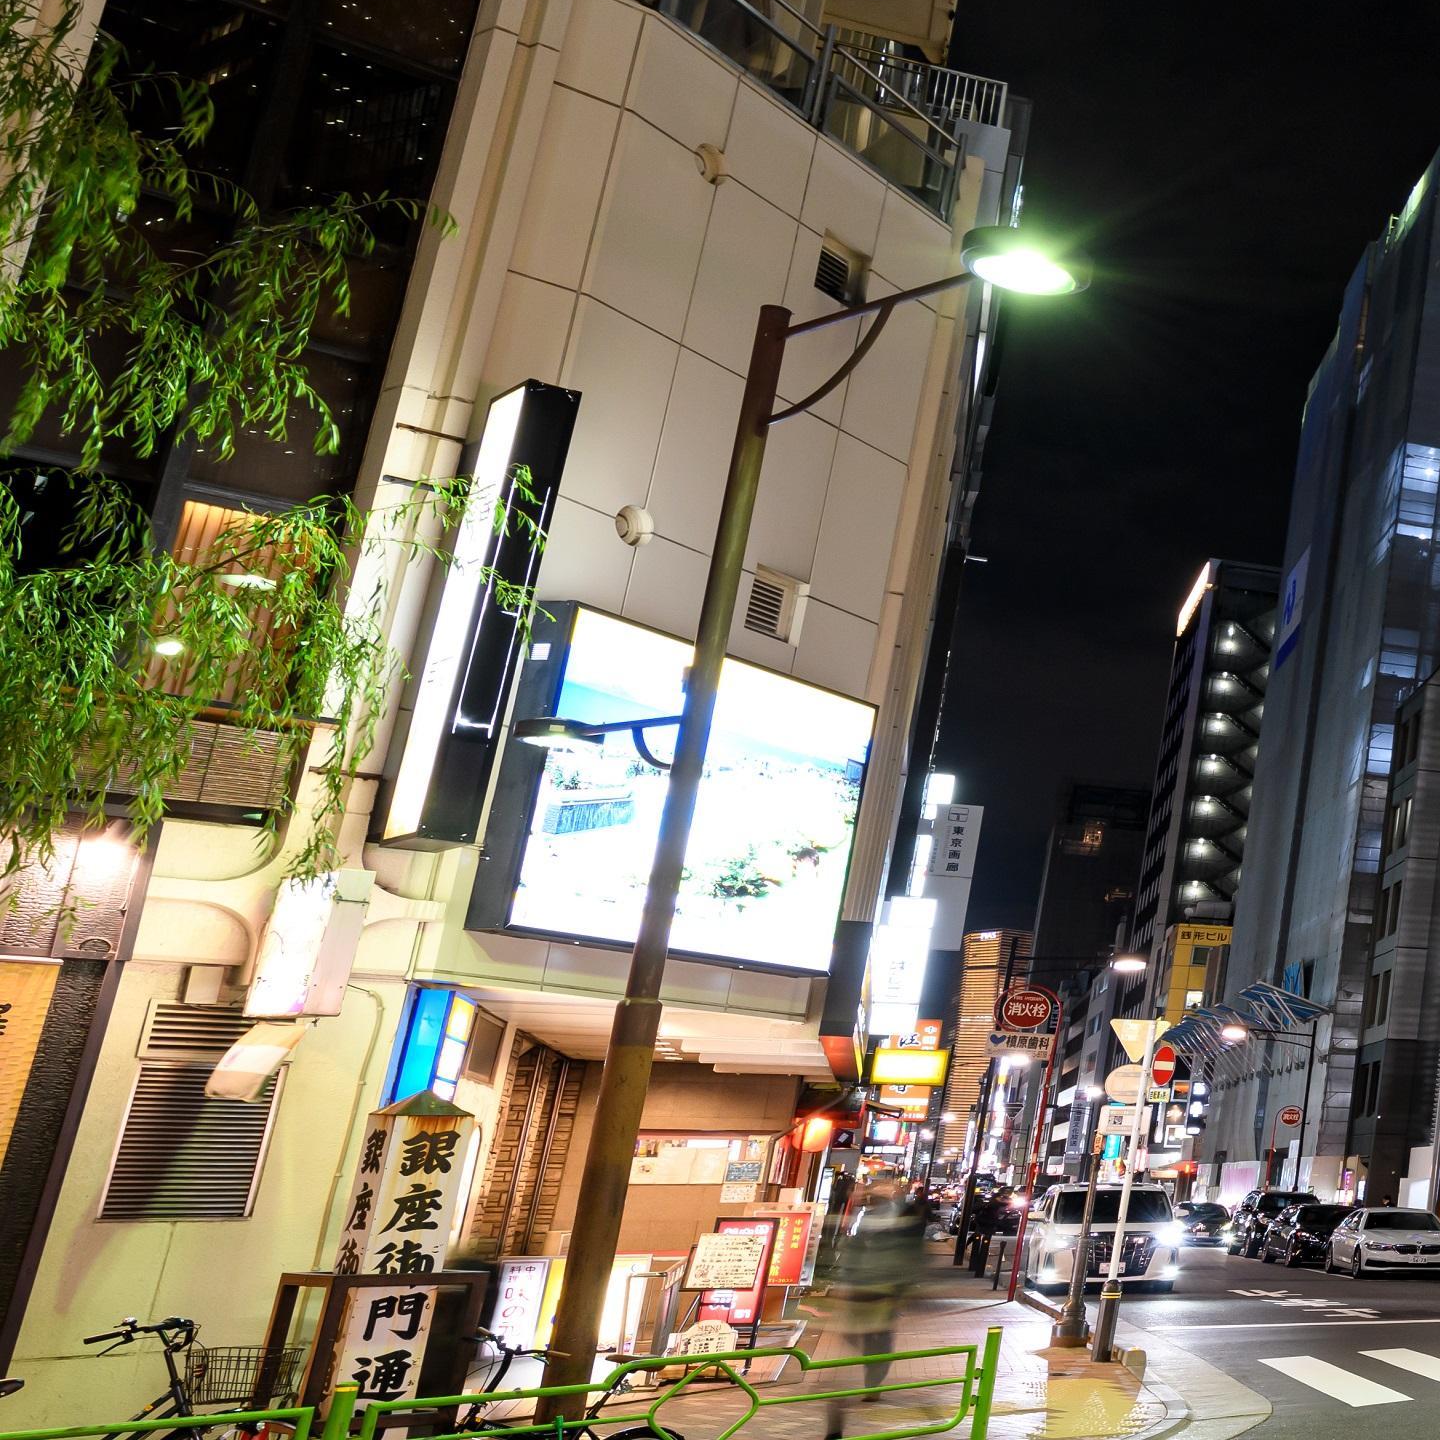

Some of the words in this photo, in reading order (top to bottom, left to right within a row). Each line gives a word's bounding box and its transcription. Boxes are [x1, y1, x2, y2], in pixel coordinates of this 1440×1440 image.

[945, 825, 965, 872] 東京画廊
[1007, 1002, 1047, 1018] 消火栓
[352, 1129, 462, 1420] 銀座御門通
